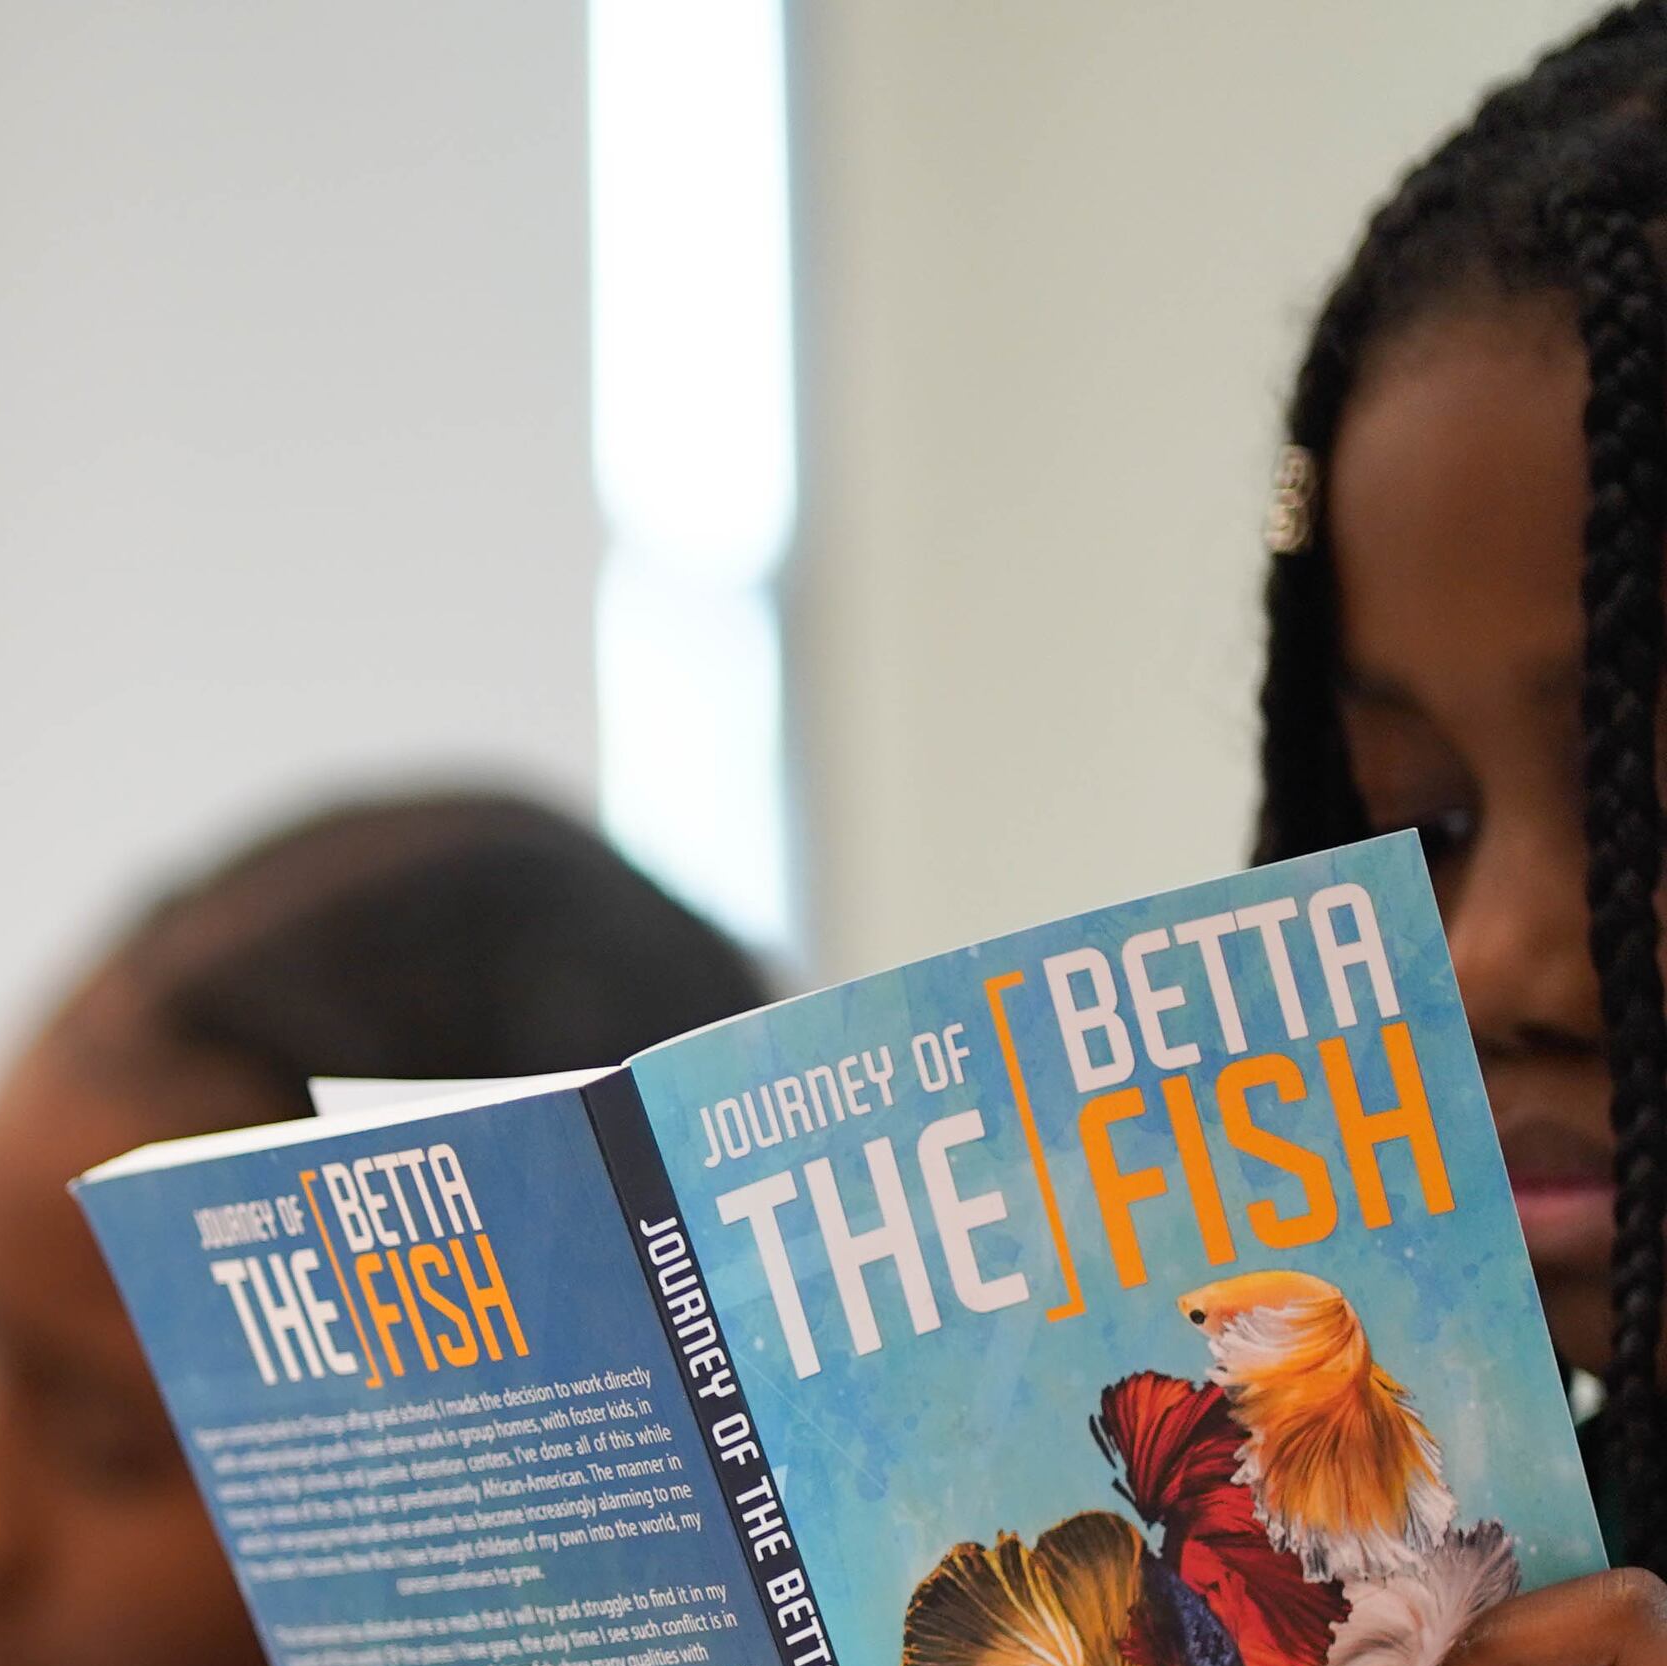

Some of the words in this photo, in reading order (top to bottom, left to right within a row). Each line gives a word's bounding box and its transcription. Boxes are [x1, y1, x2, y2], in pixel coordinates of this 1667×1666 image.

[1043, 883, 1401, 1093] BETTA
[699, 1050, 895, 1168] JOURNEY
[912, 1023, 973, 1094] OF
[1078, 1022, 1455, 1289] FISH
[193, 1199, 278, 1250] JOURNEY
[275, 1194, 305, 1238] OF
[321, 1143, 483, 1253] BETTA
[715, 1108, 1030, 1380] THE
[210, 1248, 359, 1386] THE
[355, 1234, 530, 1377] FISH
[478, 1391, 504, 1412] the
[502, 1384, 556, 1407] decision
[553, 1381, 571, 1399] to
[569, 1373, 605, 1396] work
[603, 1365, 651, 1391] directly
[639, 1216, 736, 1399] JOURNEY
[712, 1412, 760, 1465] OF
[736, 1475, 792, 1562] THE
[492, 1417, 542, 1439] homes,
[539, 1409, 571, 1431] with
[568, 1406, 607, 1426] foster
[605, 1398, 639, 1420] kids,
[636, 1397, 653, 1415] in
[512, 1445, 539, 1465] I've
[539, 1441, 574, 1461] done
[574, 1434, 592, 1456] all
[593, 1431, 608, 1453] of
[608, 1429, 636, 1450] this
[634, 1423, 672, 1445] while
[586, 1462, 615, 1483] The
[615, 1457, 665, 1479] manner
[665, 1453, 683, 1471] in
[522, 1493, 598, 1522] increasingly
[597, 1487, 656, 1512] alarming
[652, 1486, 670, 1503] to
[668, 1484, 693, 1501] me
[536, 1533, 559, 1553] my
[558, 1529, 589, 1547] own
[586, 1523, 616, 1542] into
[614, 1518, 639, 1539] the
[637, 1511, 680, 1535] world,
[679, 1512, 702, 1532] my
[554, 1599, 582, 1621] and
[580, 1592, 634, 1619] struggle
[632, 1593, 650, 1610] to
[648, 1586, 678, 1608] find
[676, 1586, 690, 1604] it
[687, 1584, 705, 1603] in
[704, 1584, 727, 1604] my
[598, 1625, 608, 1645] I
[606, 1626, 631, 1644] see
[630, 1618, 662, 1641] such
[661, 1613, 710, 1637] conflict
[707, 1611, 722, 1630] is
[720, 1609, 738, 1628] in
[678, 1641, 710, 1663] with
